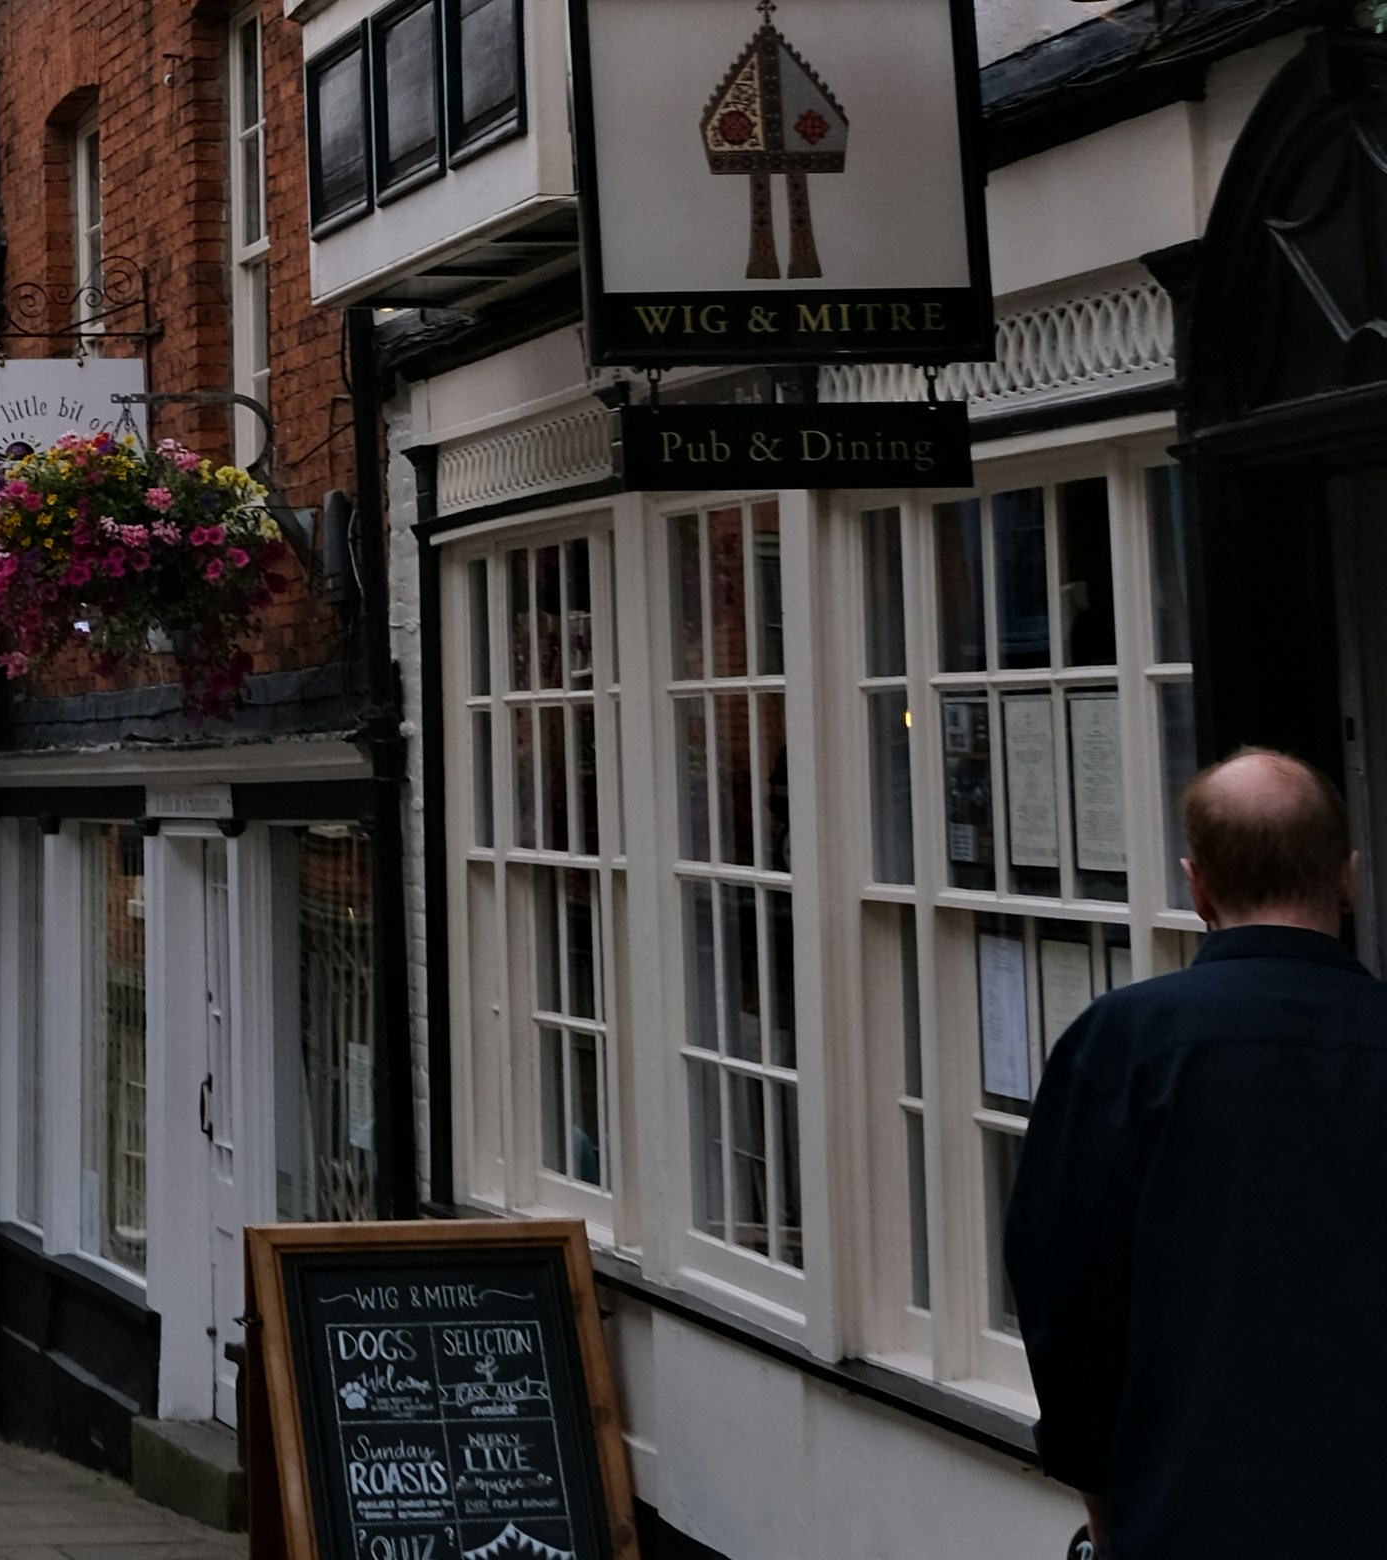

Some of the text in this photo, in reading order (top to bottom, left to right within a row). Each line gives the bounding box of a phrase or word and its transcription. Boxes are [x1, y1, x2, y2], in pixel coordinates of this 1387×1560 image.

[634, 302, 947, 335] WIG & MITRE
[0, 394, 47, 423] little
[57, 395, 84, 423] bit
[660, 429, 937, 471] Pub & Dining
[355, 1283, 479, 1311] WIG & MITRE
[337, 1328, 418, 1361] DOGS
[442, 1327, 533, 1357] SELECTION
[349, 1434, 436, 1465] Sunday
[467, 1432, 521, 1448] WEEKLY
[463, 1446, 534, 1472] LIVE
[347, 1460, 448, 1496] ROASTS
